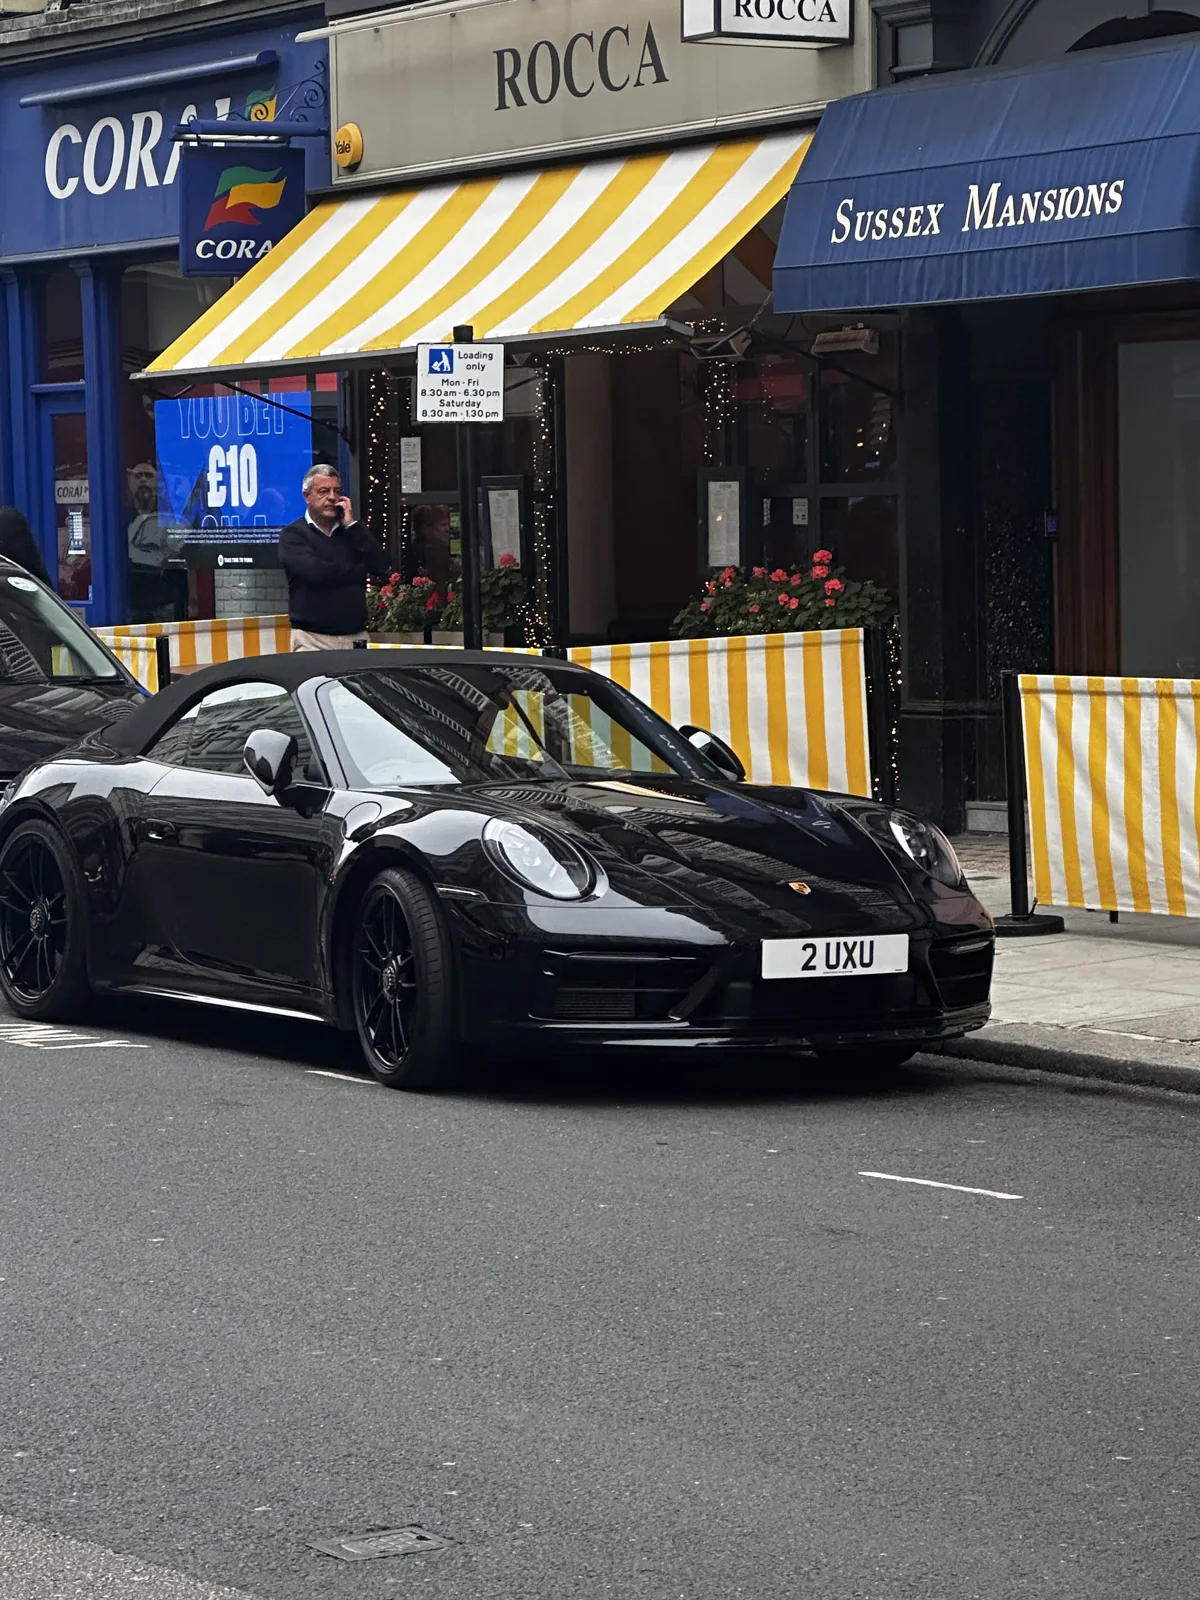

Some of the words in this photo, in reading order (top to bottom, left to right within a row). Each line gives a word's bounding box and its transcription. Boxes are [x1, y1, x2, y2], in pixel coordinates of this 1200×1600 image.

[733, 0, 838, 22] ROCCA
[493, 20, 669, 111] ROCCA
[334, 140, 351, 154] Yale
[830, 199, 944, 244] SUSSEX
[961, 180, 1125, 231] MANSIONS
[195, 239, 274, 259] CORA
[458, 351, 493, 360] Loading
[465, 362, 486, 371] only
[441, 378, 460, 386] Mon
[467, 378, 479, 386] Fri
[439, 399, 481, 408] Saturday
[177, 395, 230, 439] YOU
[207, 443, 258, 507] £10
[801, 942, 817, 971] 2
[825, 940, 874, 970] UXU
